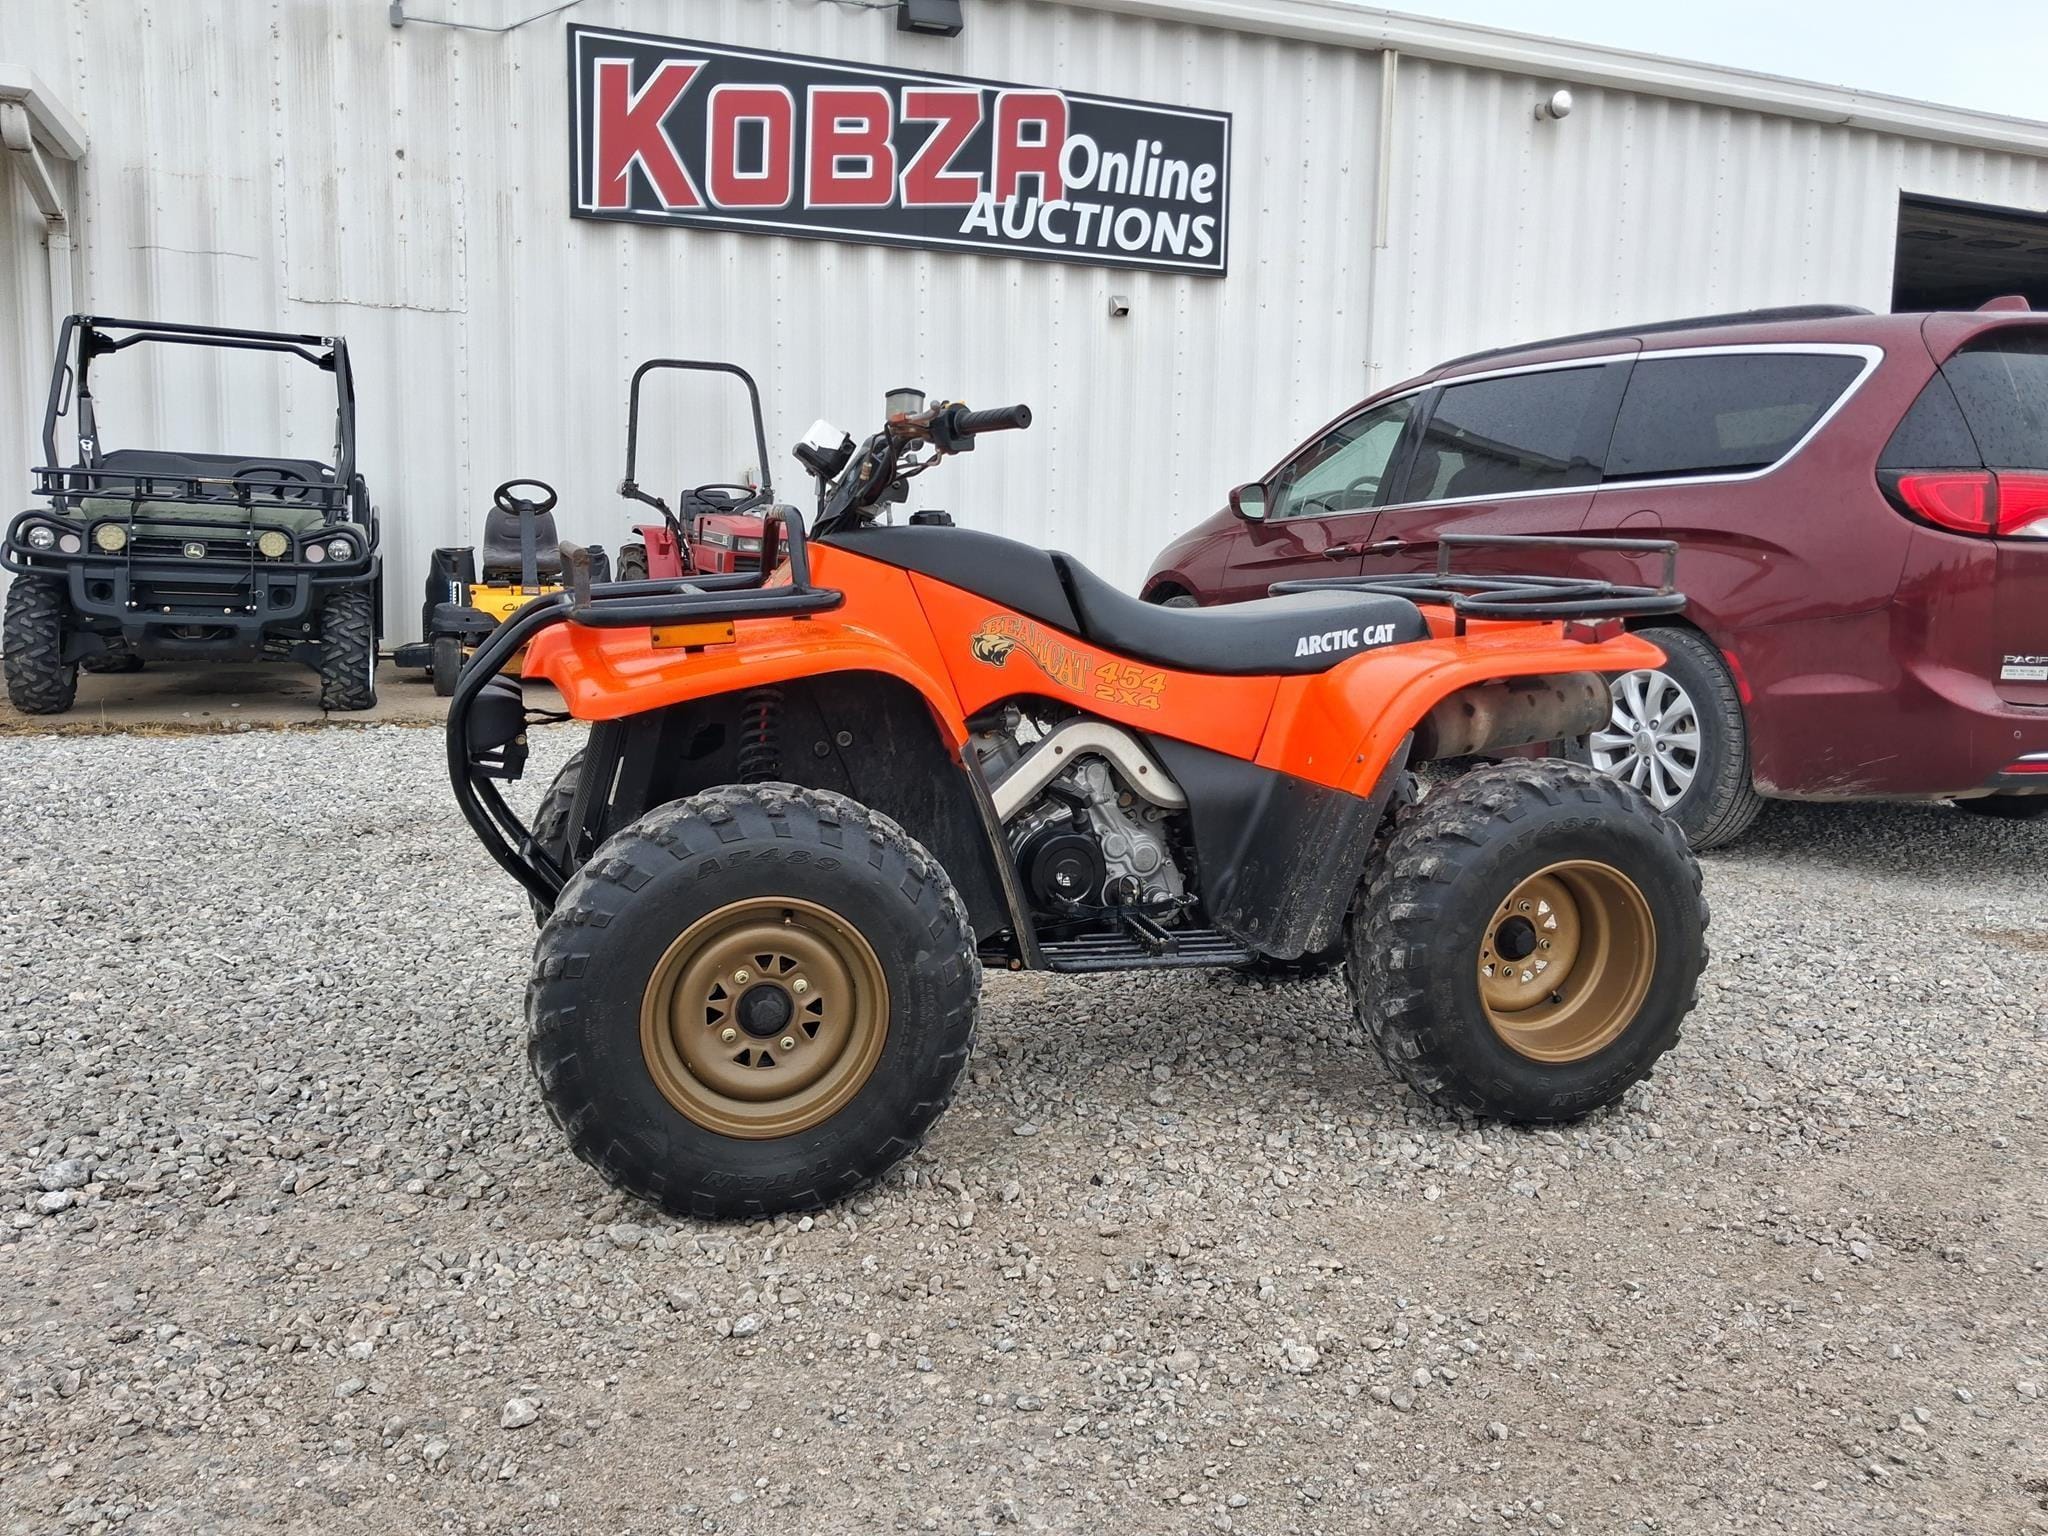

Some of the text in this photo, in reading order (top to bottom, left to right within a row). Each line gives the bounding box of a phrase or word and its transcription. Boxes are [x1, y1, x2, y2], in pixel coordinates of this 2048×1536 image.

[593, 57, 1068, 212] KOBZA
[1058, 133, 1214, 204] Online
[960, 191, 1215, 258] AUCTIONS
[984, 616, 1092, 693] BEARCAT
[1295, 624, 1396, 657] ARCTIC CAT
[1094, 683, 1160, 711] 2X4
[1095, 662, 1168, 694] 454
[696, 847, 841, 881] AT489
